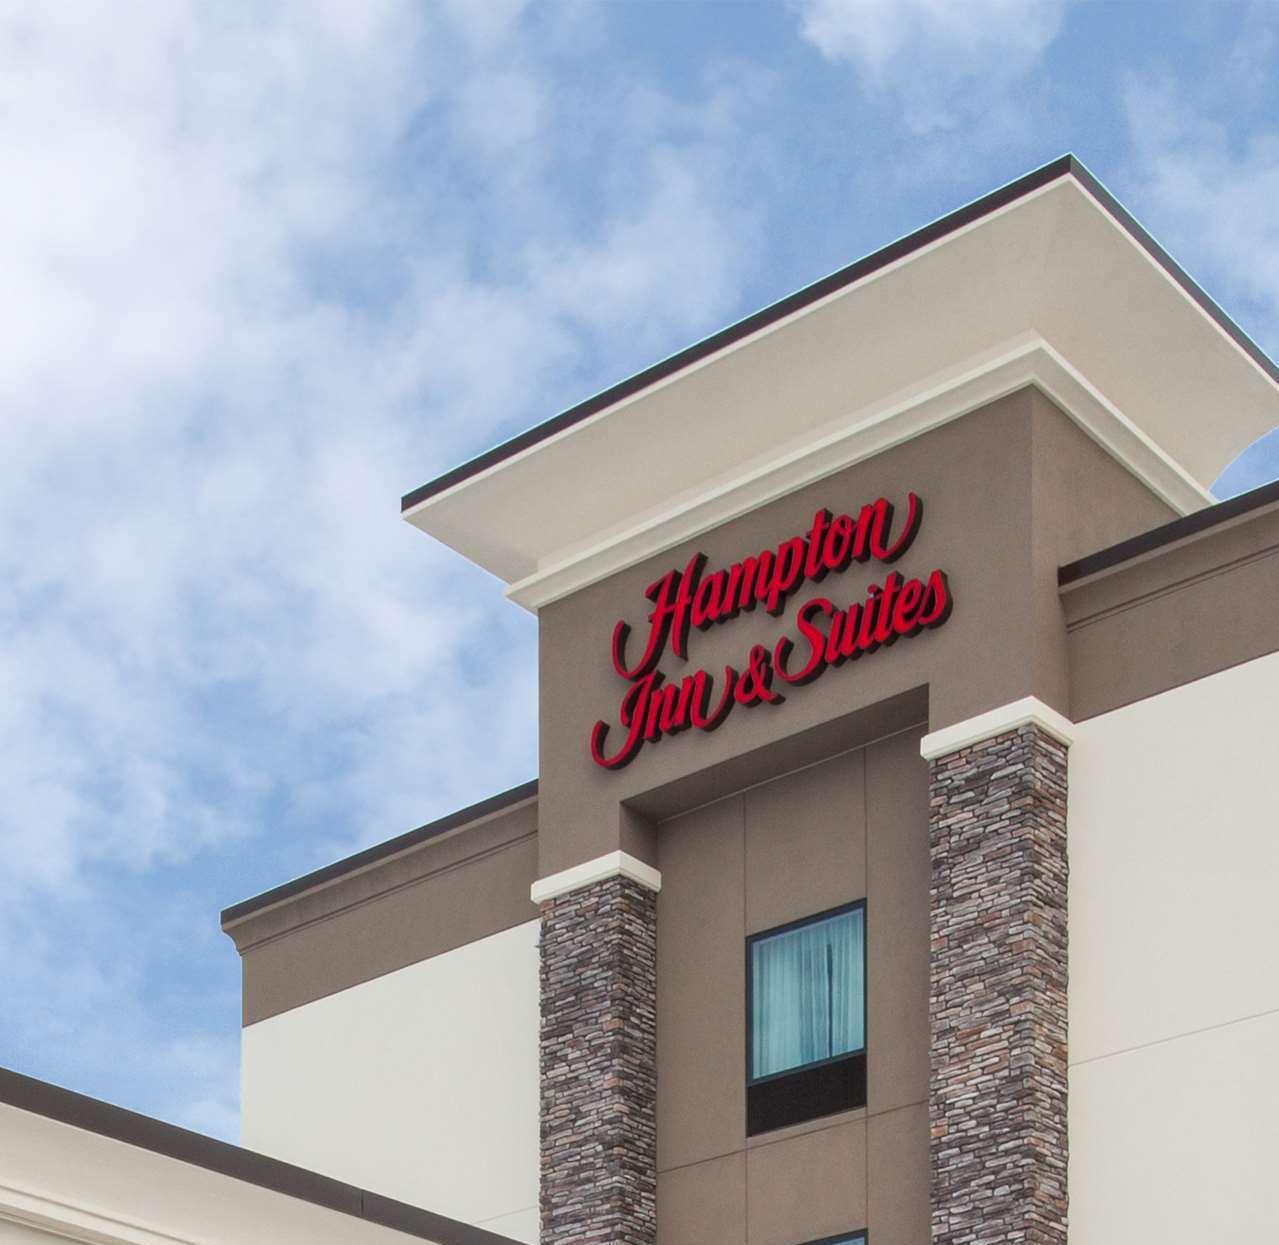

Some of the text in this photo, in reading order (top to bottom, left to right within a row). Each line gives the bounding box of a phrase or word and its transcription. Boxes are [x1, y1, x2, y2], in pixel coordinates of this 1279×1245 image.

[591, 568, 953, 769] Inn & Suites
[612, 491, 923, 680] Hampton
